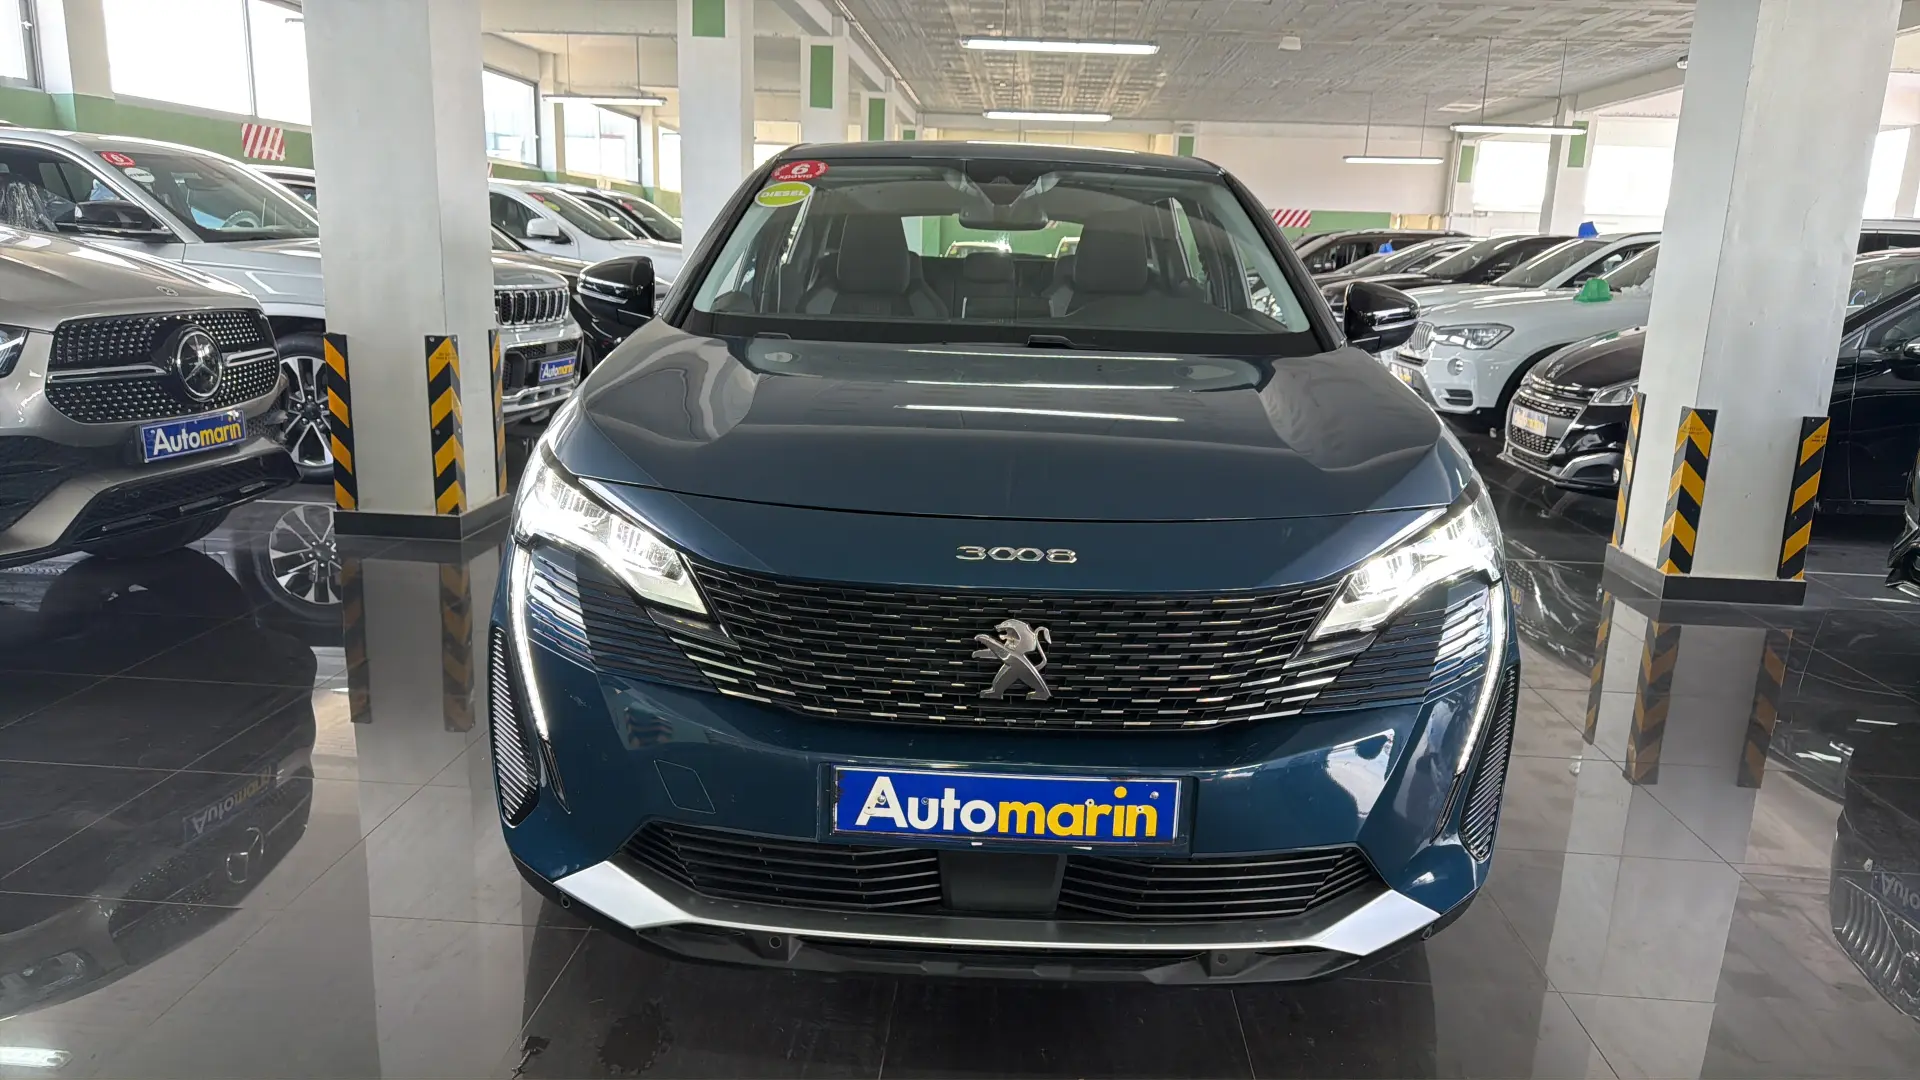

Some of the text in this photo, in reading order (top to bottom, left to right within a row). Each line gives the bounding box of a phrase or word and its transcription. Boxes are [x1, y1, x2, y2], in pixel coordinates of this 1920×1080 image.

[791, 163, 811, 175] 6
[760, 189, 806, 198] DIESEL
[153, 416, 242, 456] Automarin
[955, 545, 1078, 563] 3008
[855, 776, 1158, 837] Automarin
